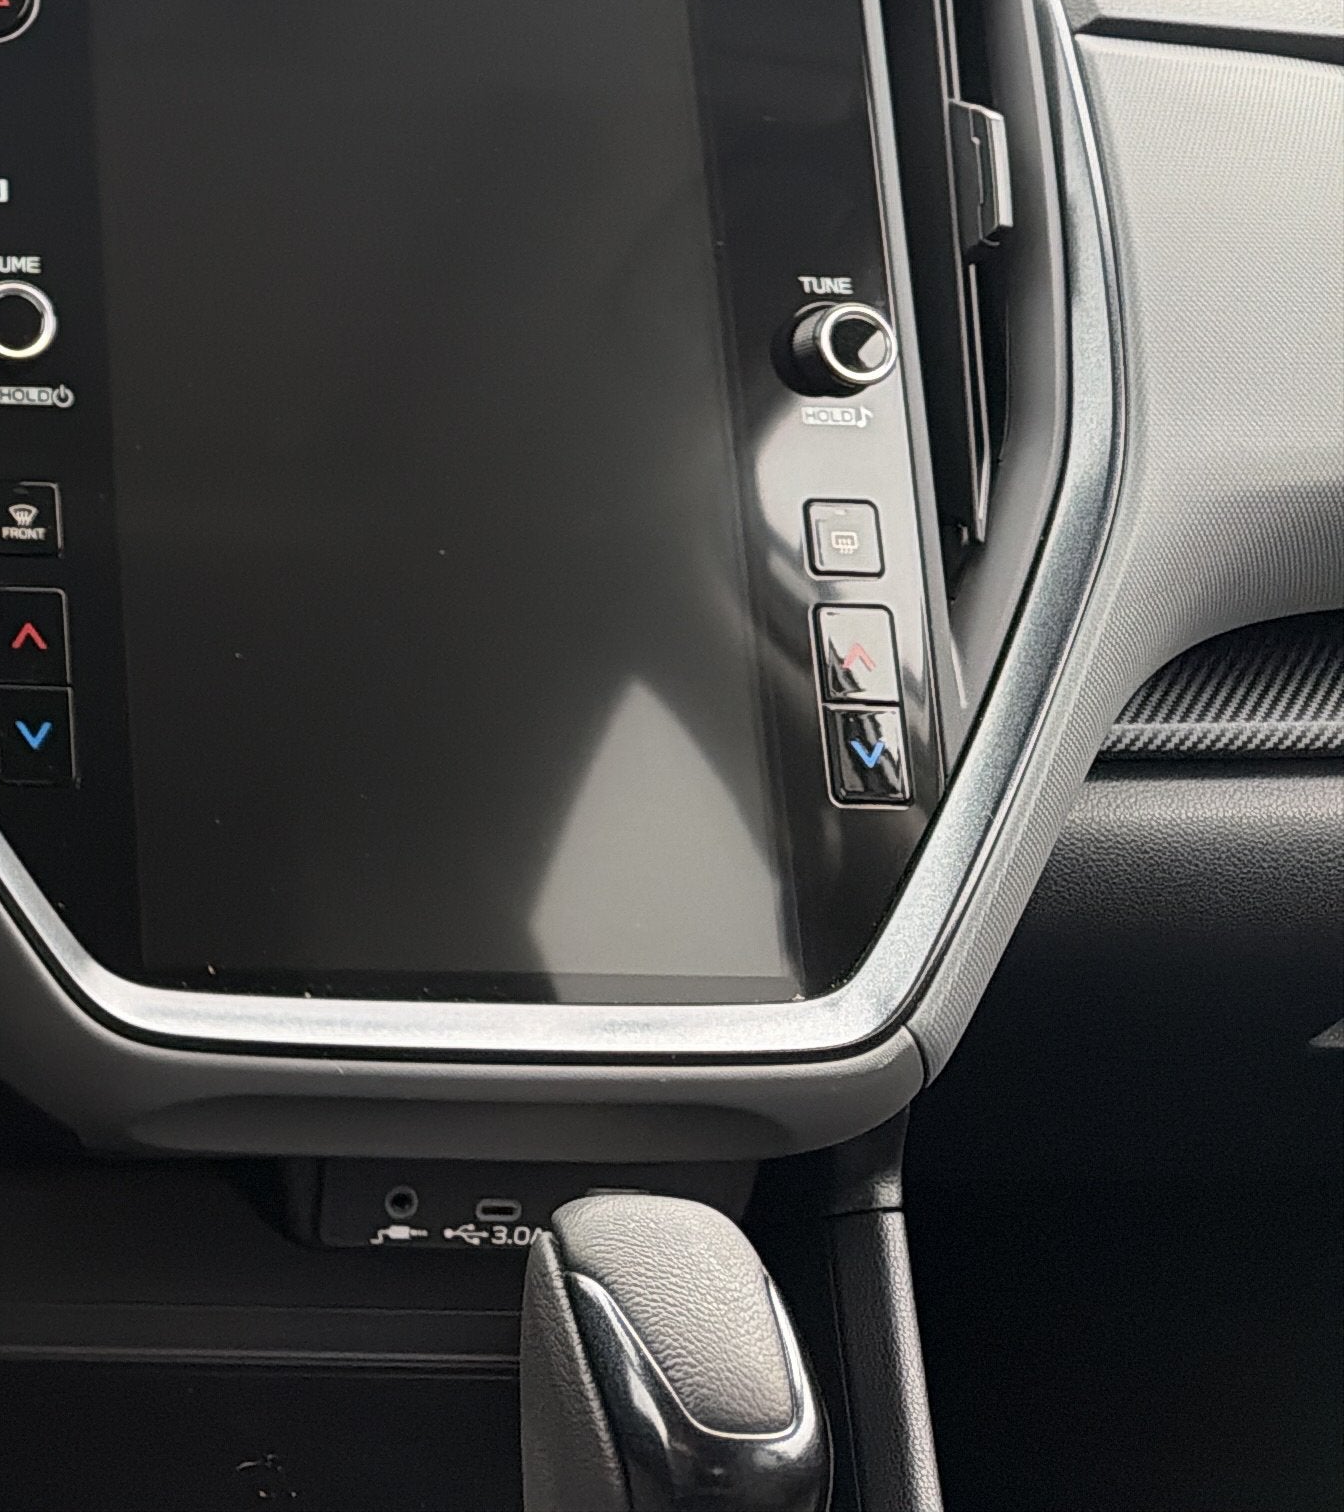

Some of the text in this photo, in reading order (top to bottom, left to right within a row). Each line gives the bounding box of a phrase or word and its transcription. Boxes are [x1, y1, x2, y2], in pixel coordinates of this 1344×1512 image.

[798, 276, 854, 295] TUNE
[803, 409, 855, 424] HOLD
[1, 526, 47, 541] FRONT
